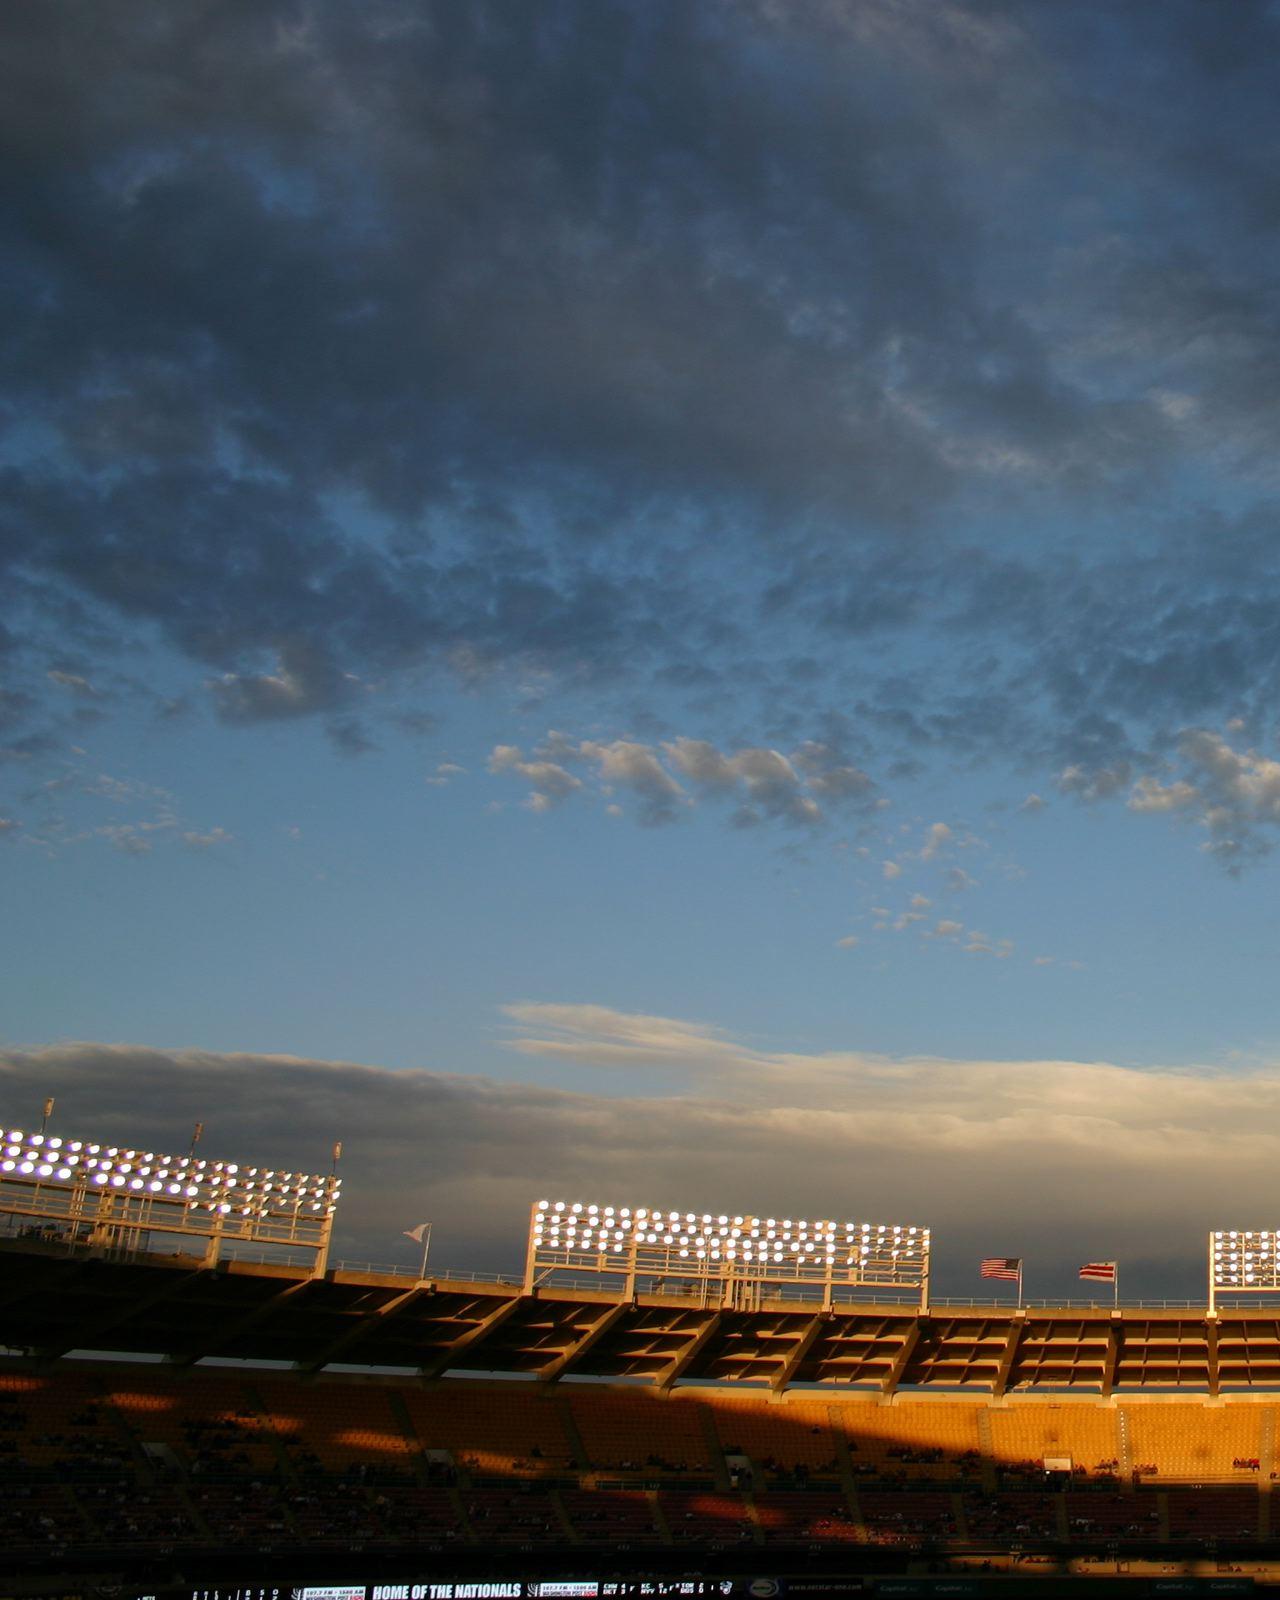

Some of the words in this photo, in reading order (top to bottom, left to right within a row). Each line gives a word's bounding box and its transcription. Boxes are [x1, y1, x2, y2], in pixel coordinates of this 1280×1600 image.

[373, 1586, 409, 1600] HOME
[411, 1585, 428, 1599] OF
[429, 1584, 453, 1598] THE
[454, 1583, 522, 1598] NATIONALS
